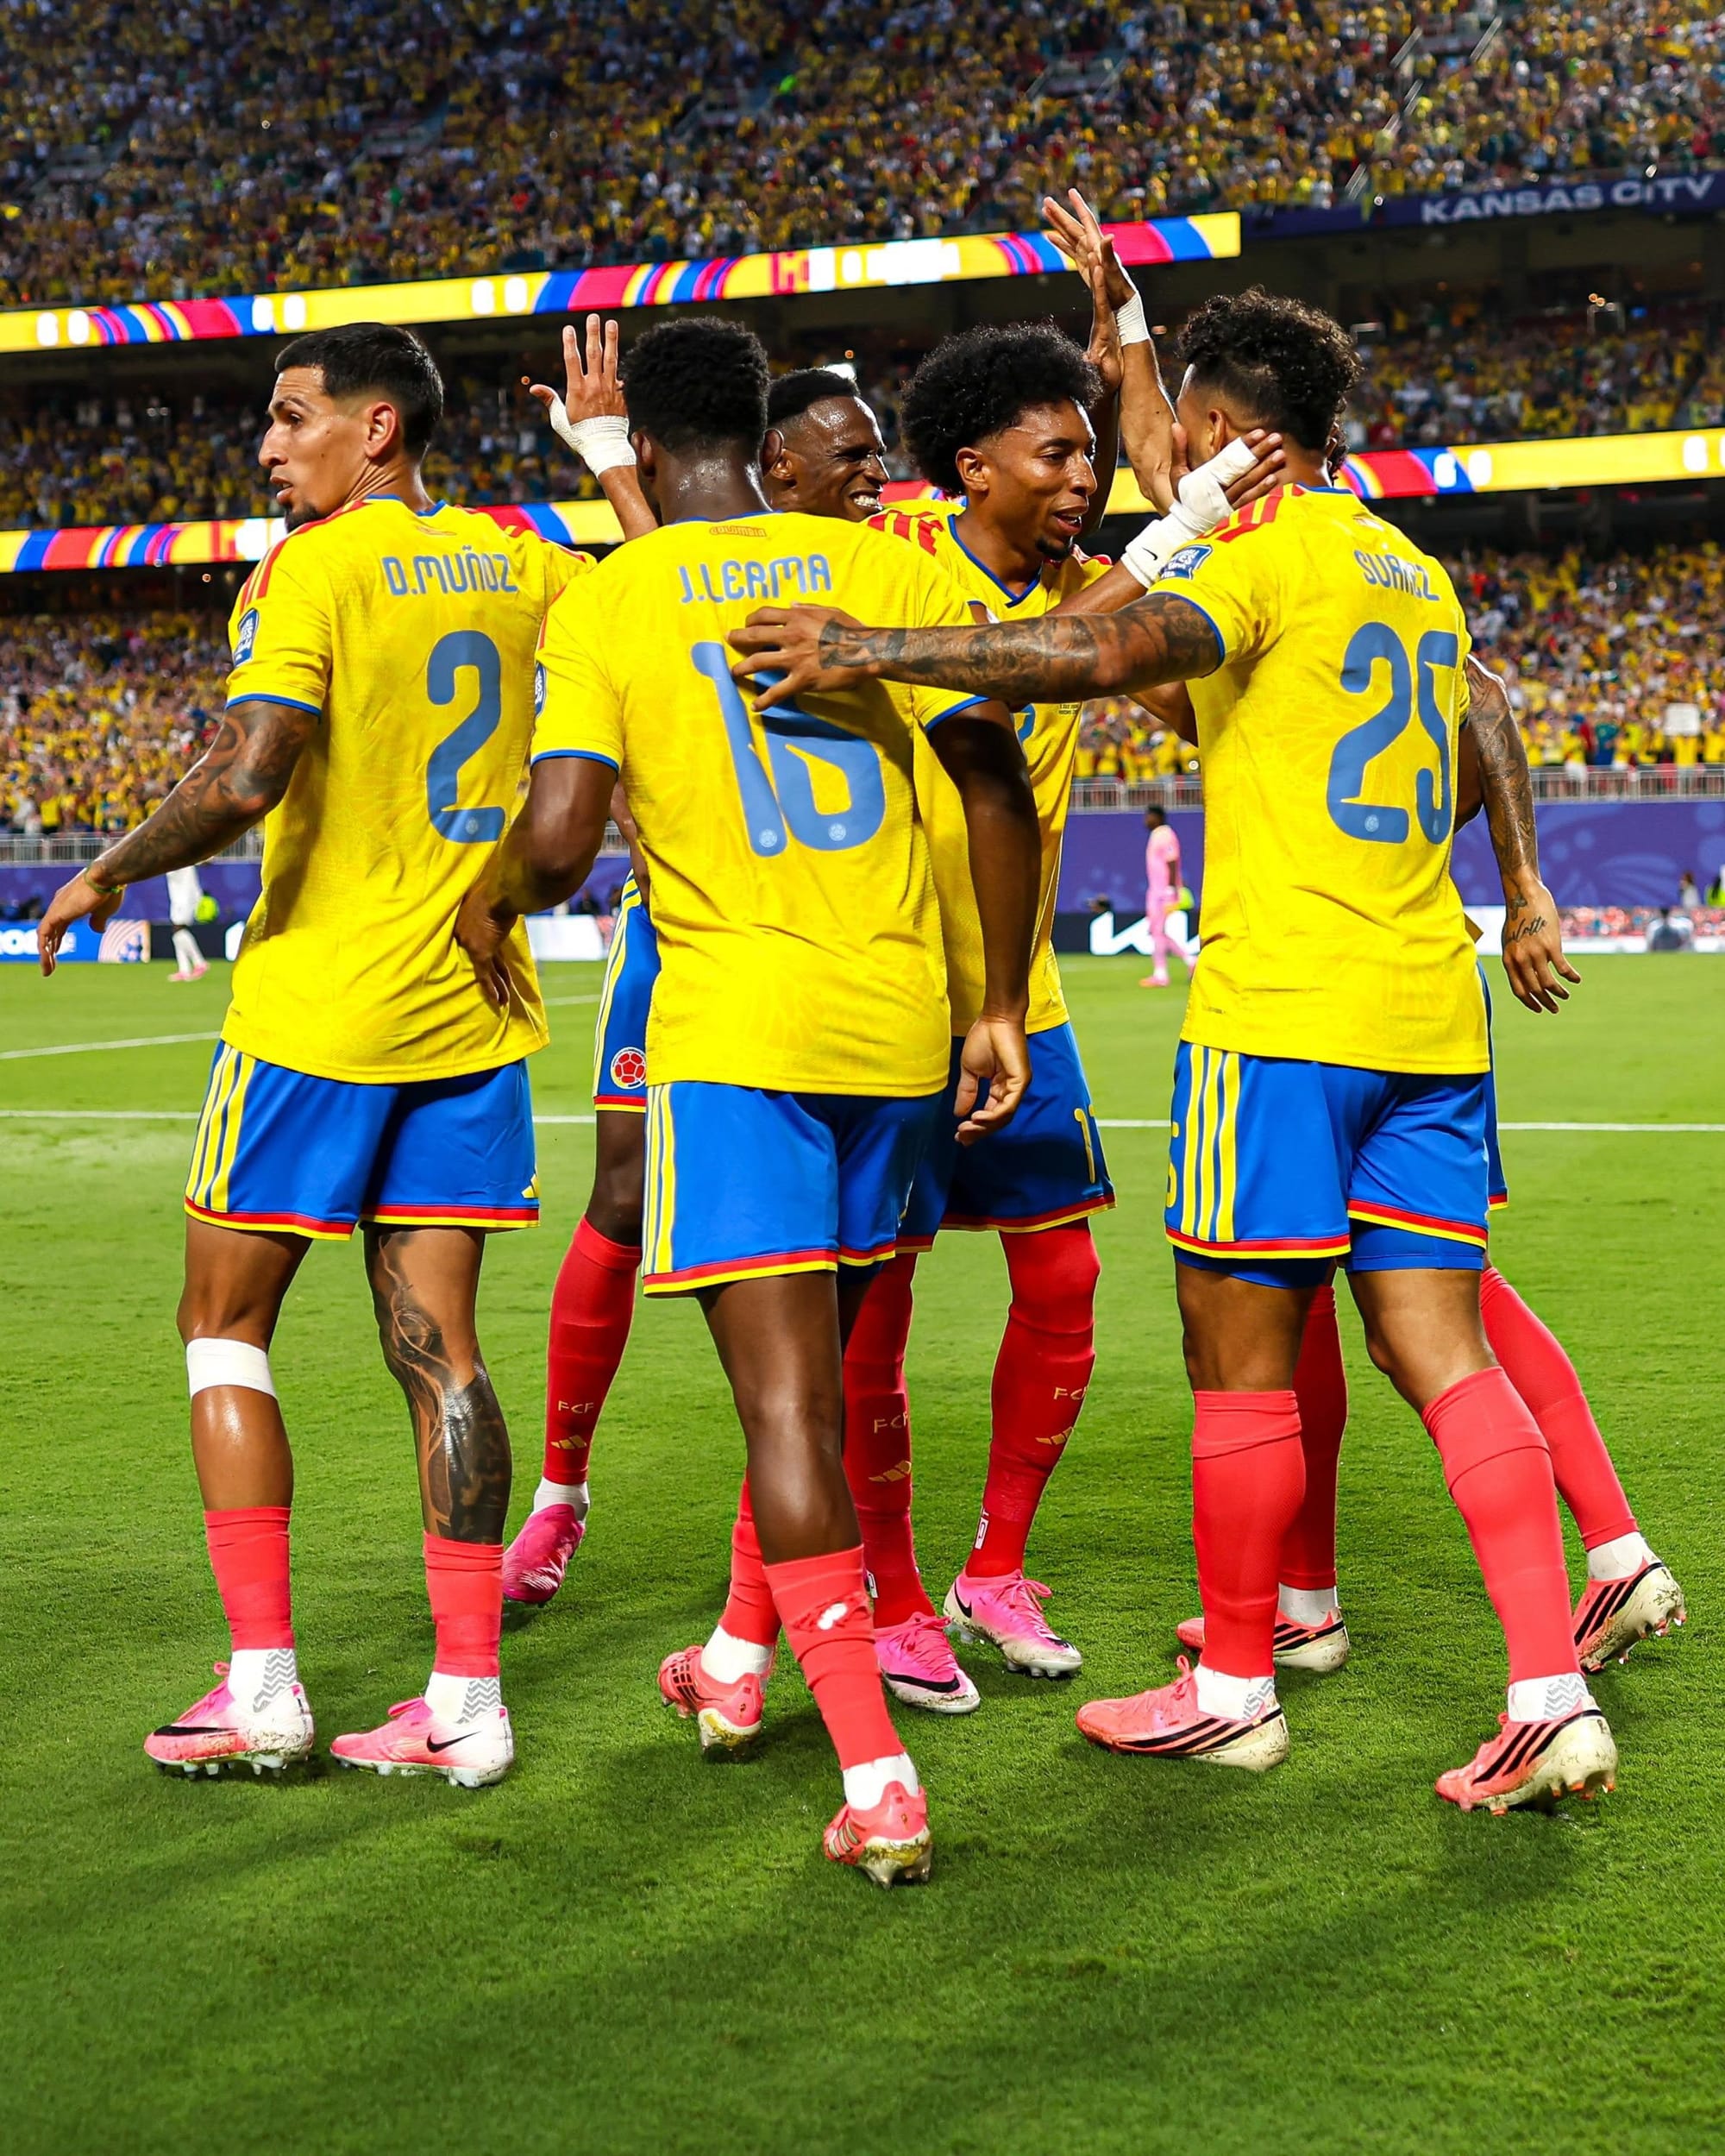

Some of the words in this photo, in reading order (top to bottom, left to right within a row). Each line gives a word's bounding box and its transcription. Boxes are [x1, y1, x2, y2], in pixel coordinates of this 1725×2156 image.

[1421, 184, 1603, 224] KANSAS
[1611, 174, 1716, 204] CITY
[381, 544, 518, 596] D.MUÑOZ
[679, 553, 832, 604] J.LERMA
[426, 629, 505, 843] 2
[690, 641, 886, 858] 16
[1327, 621, 1458, 845] 25
[557, 1399, 594, 1414] FCF
[1053, 1386, 1088, 1401] FC
